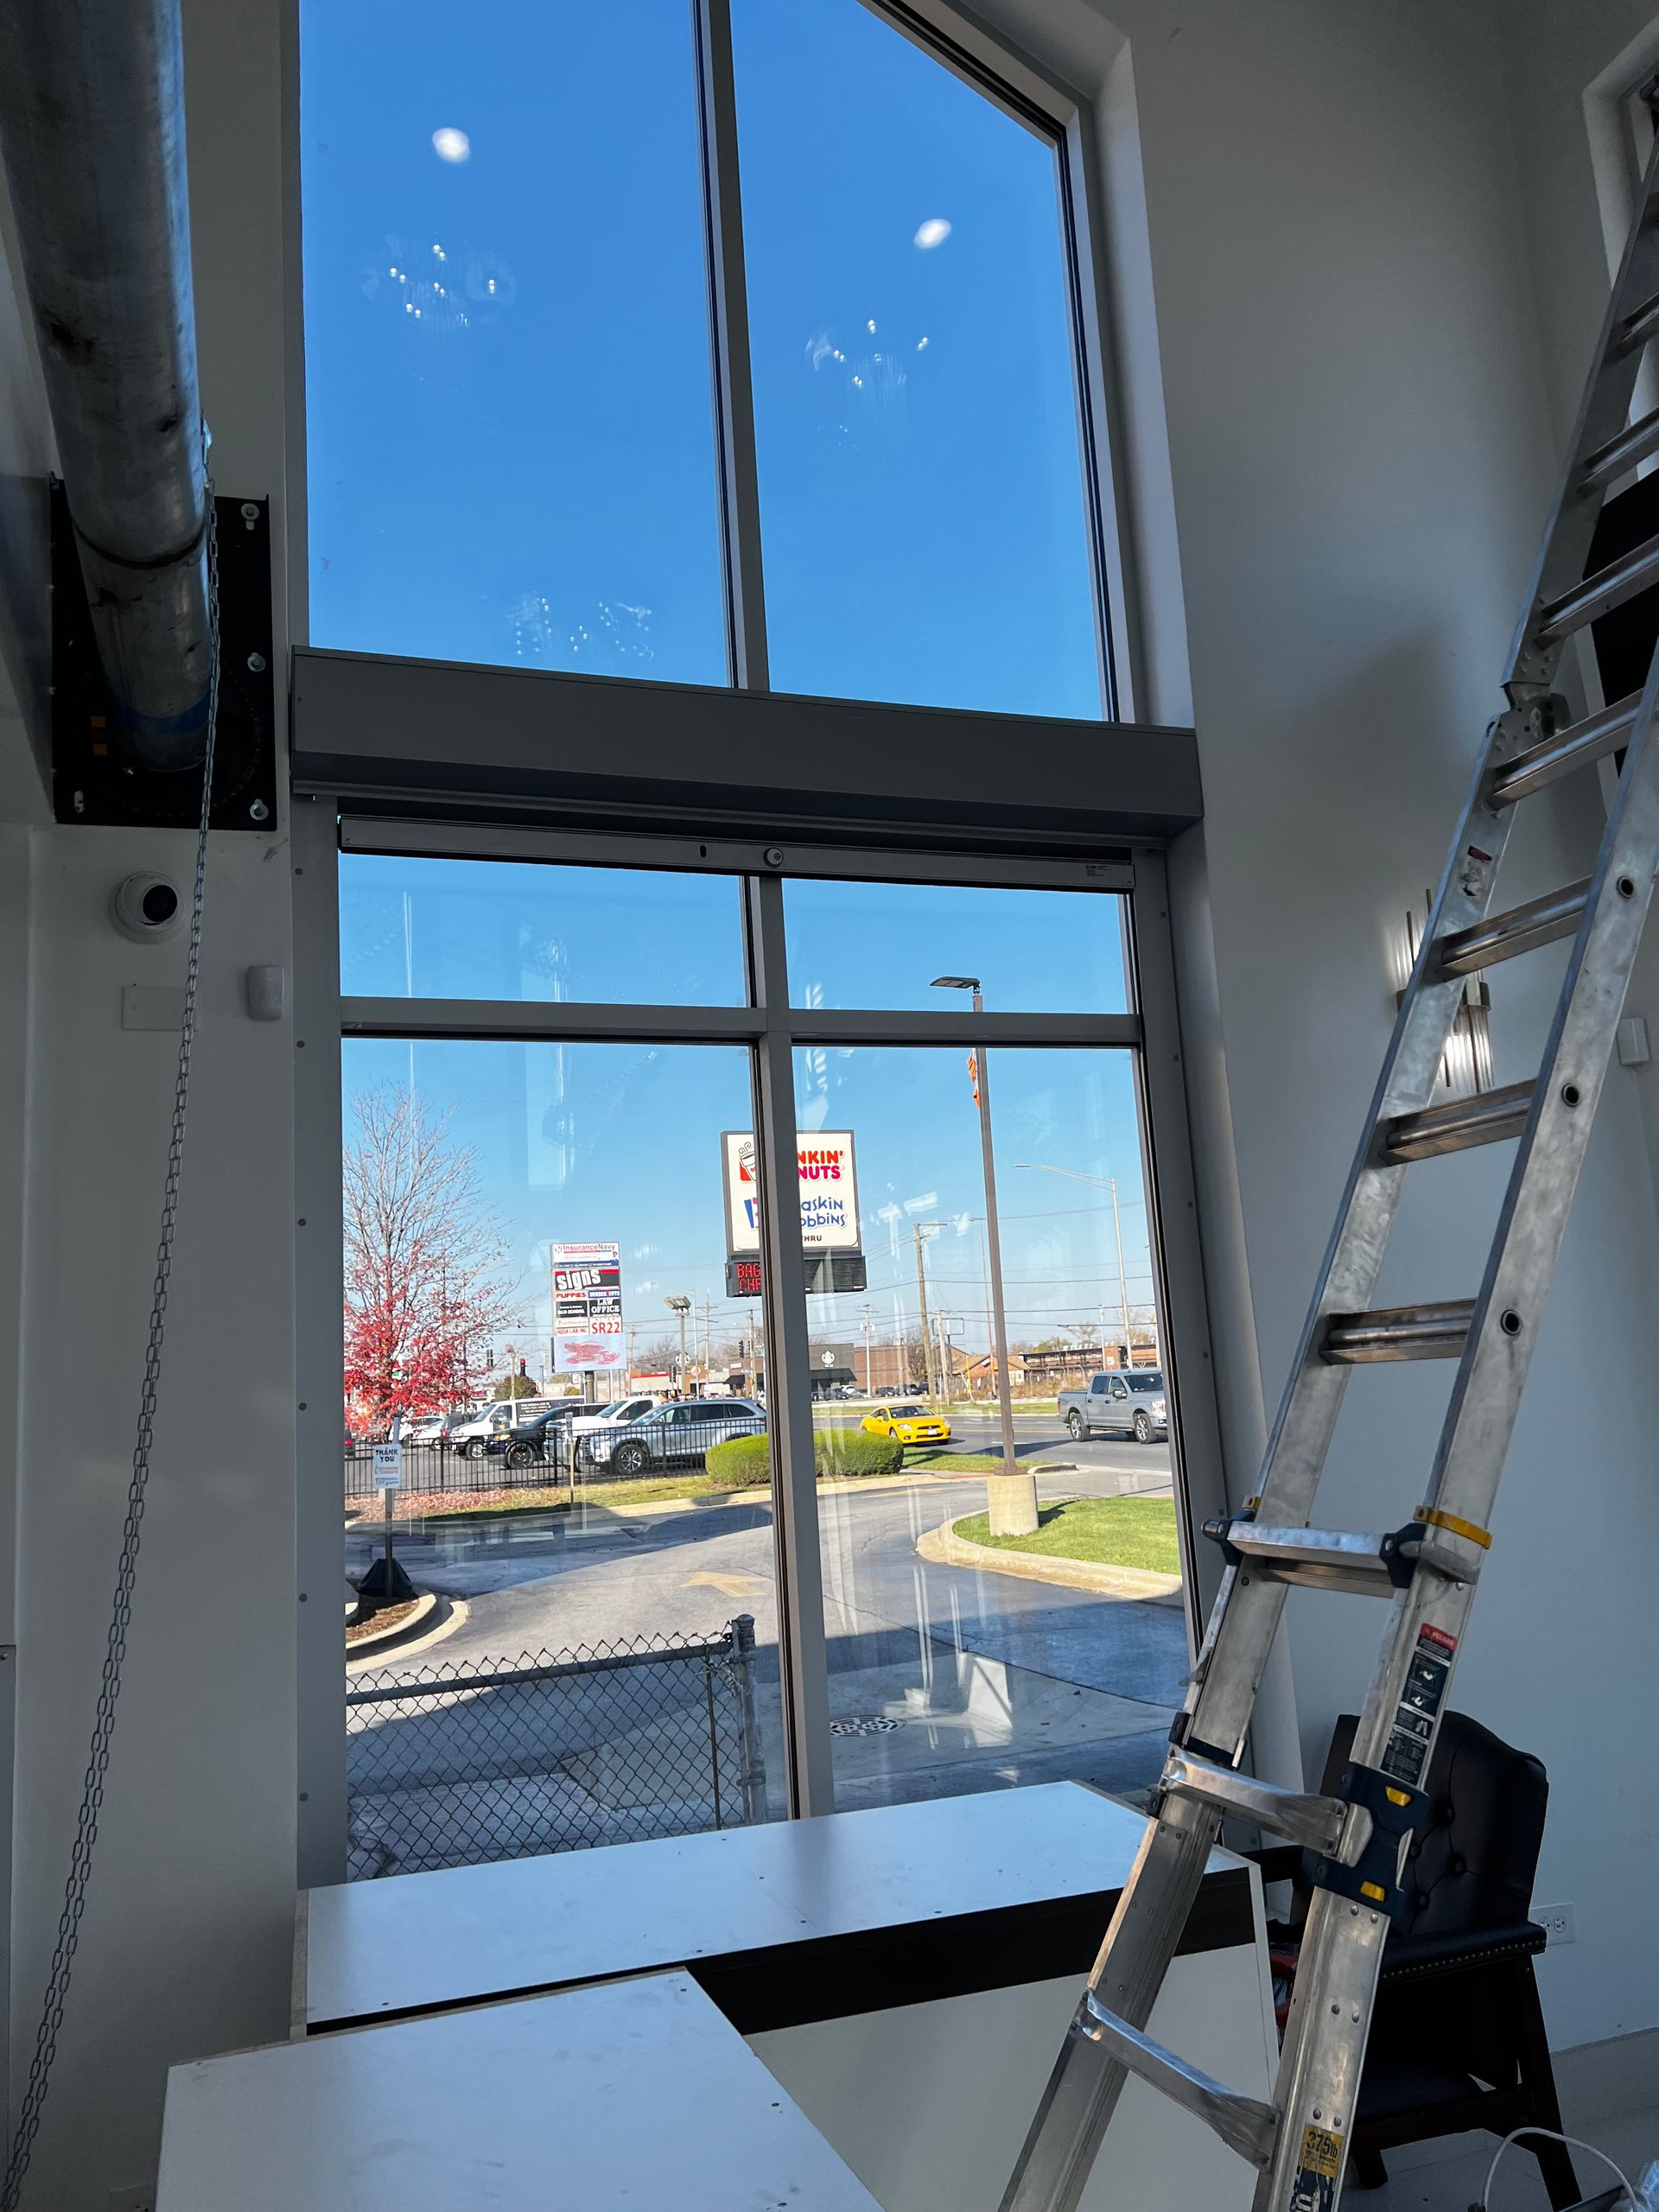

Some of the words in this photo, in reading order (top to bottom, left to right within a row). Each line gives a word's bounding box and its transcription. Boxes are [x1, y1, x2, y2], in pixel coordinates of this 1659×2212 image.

[798, 1150, 844, 1165] NKIN'
[798, 1165, 842, 1180] NUTS
[801, 1196, 843, 1211] askin
[801, 1212, 846, 1228] obbins
[556, 1269, 601, 1290] signs
[591, 1305, 620, 1313] OFFICE
[591, 1322, 620, 1335] SR22
